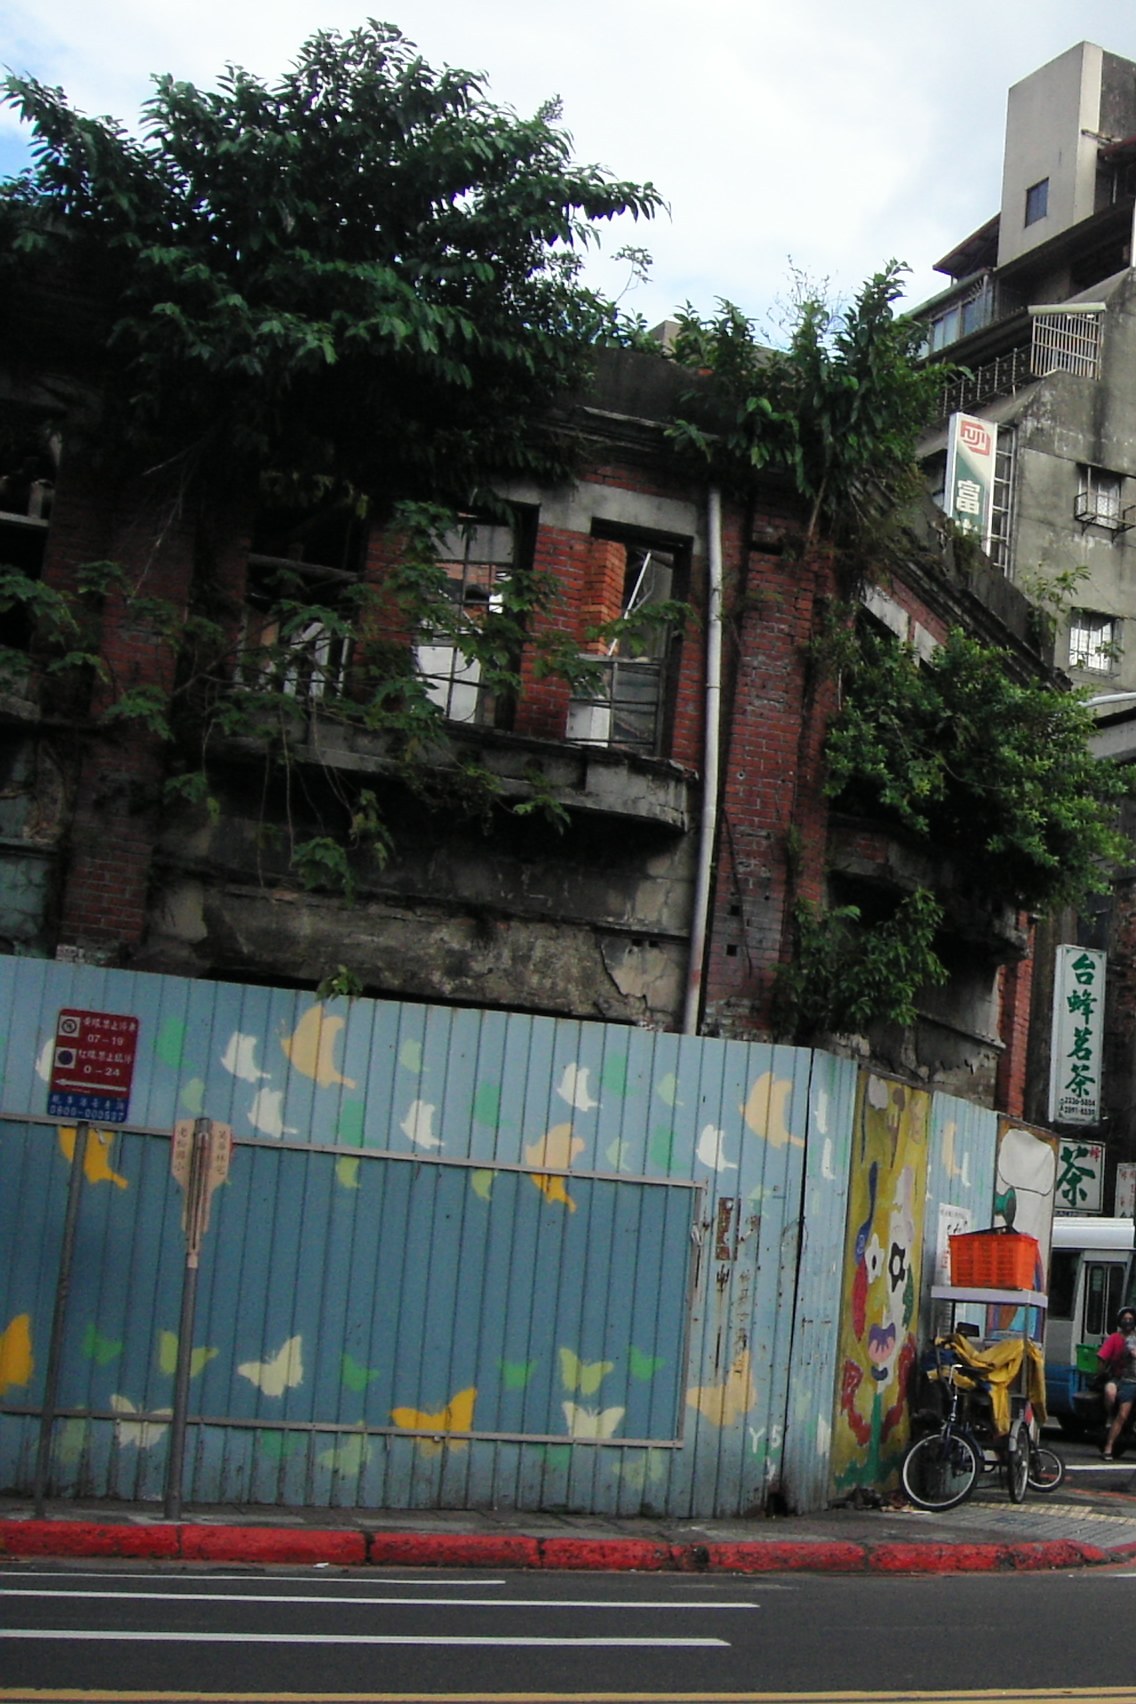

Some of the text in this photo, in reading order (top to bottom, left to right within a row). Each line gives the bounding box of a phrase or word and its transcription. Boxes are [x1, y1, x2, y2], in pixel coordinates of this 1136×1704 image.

[1065, 953, 1098, 1098] 台蜂茗茶
[1056, 1145, 1096, 1207] 茶
